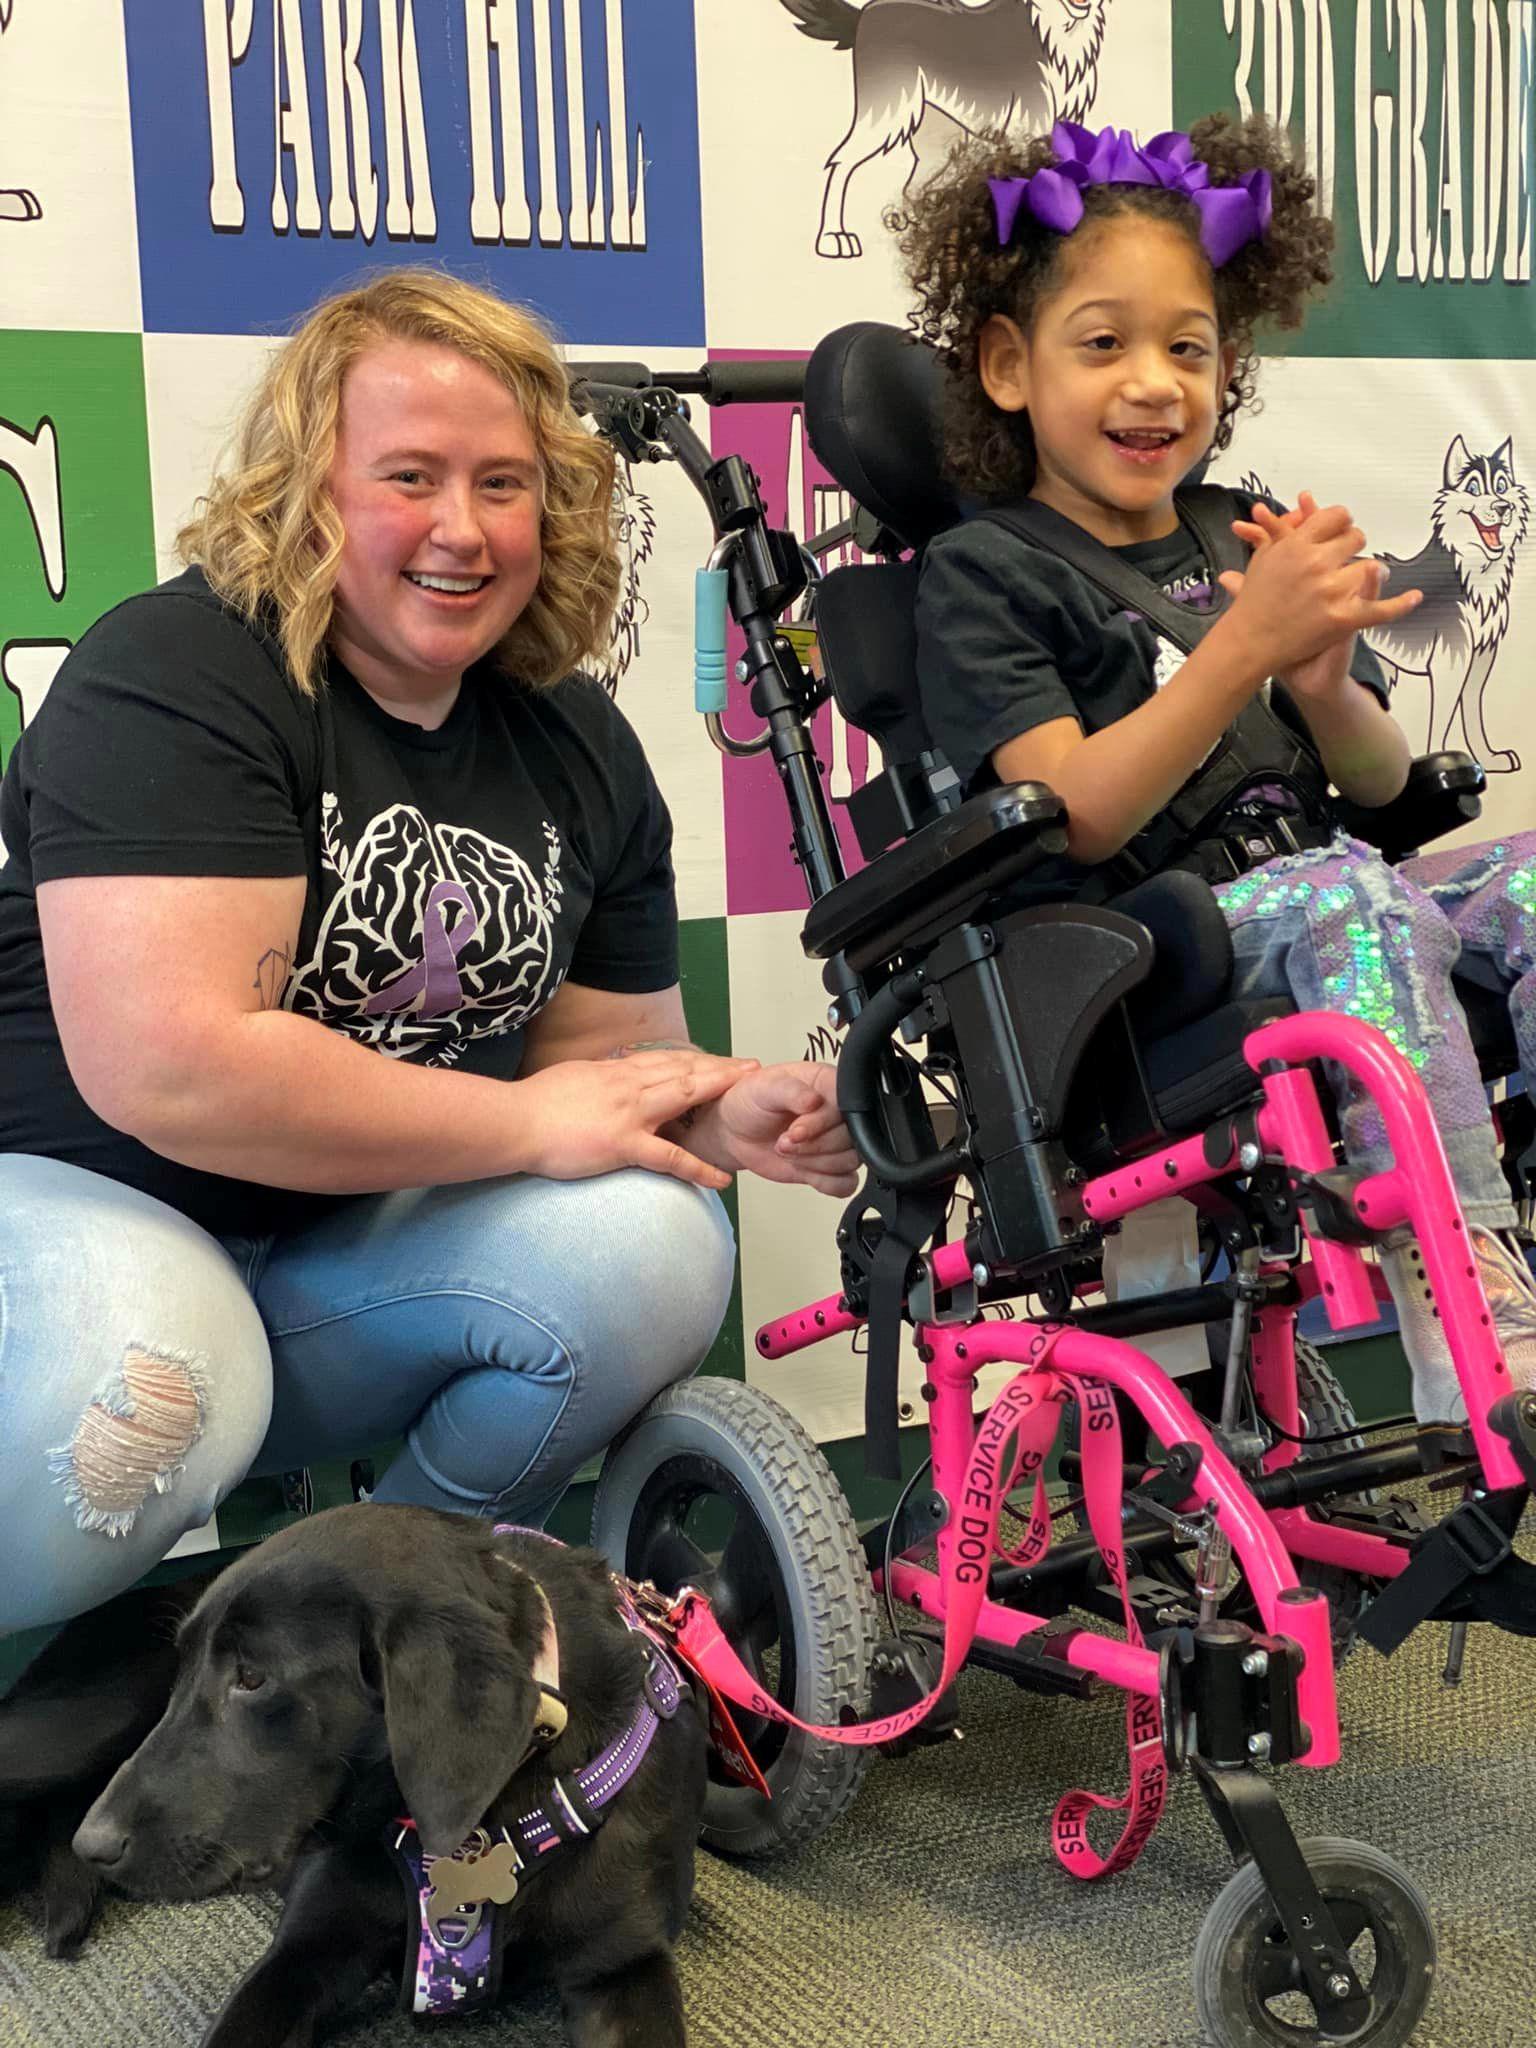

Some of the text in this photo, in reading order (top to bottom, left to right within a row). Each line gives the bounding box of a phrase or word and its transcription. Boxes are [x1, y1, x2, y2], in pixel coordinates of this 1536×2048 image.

[202, 0, 648, 252] PARK HILL
[1353, 0, 1533, 287] GRADE
[965, 1384, 1033, 1513] SERVICE
[955, 1516, 990, 1585] DOG
